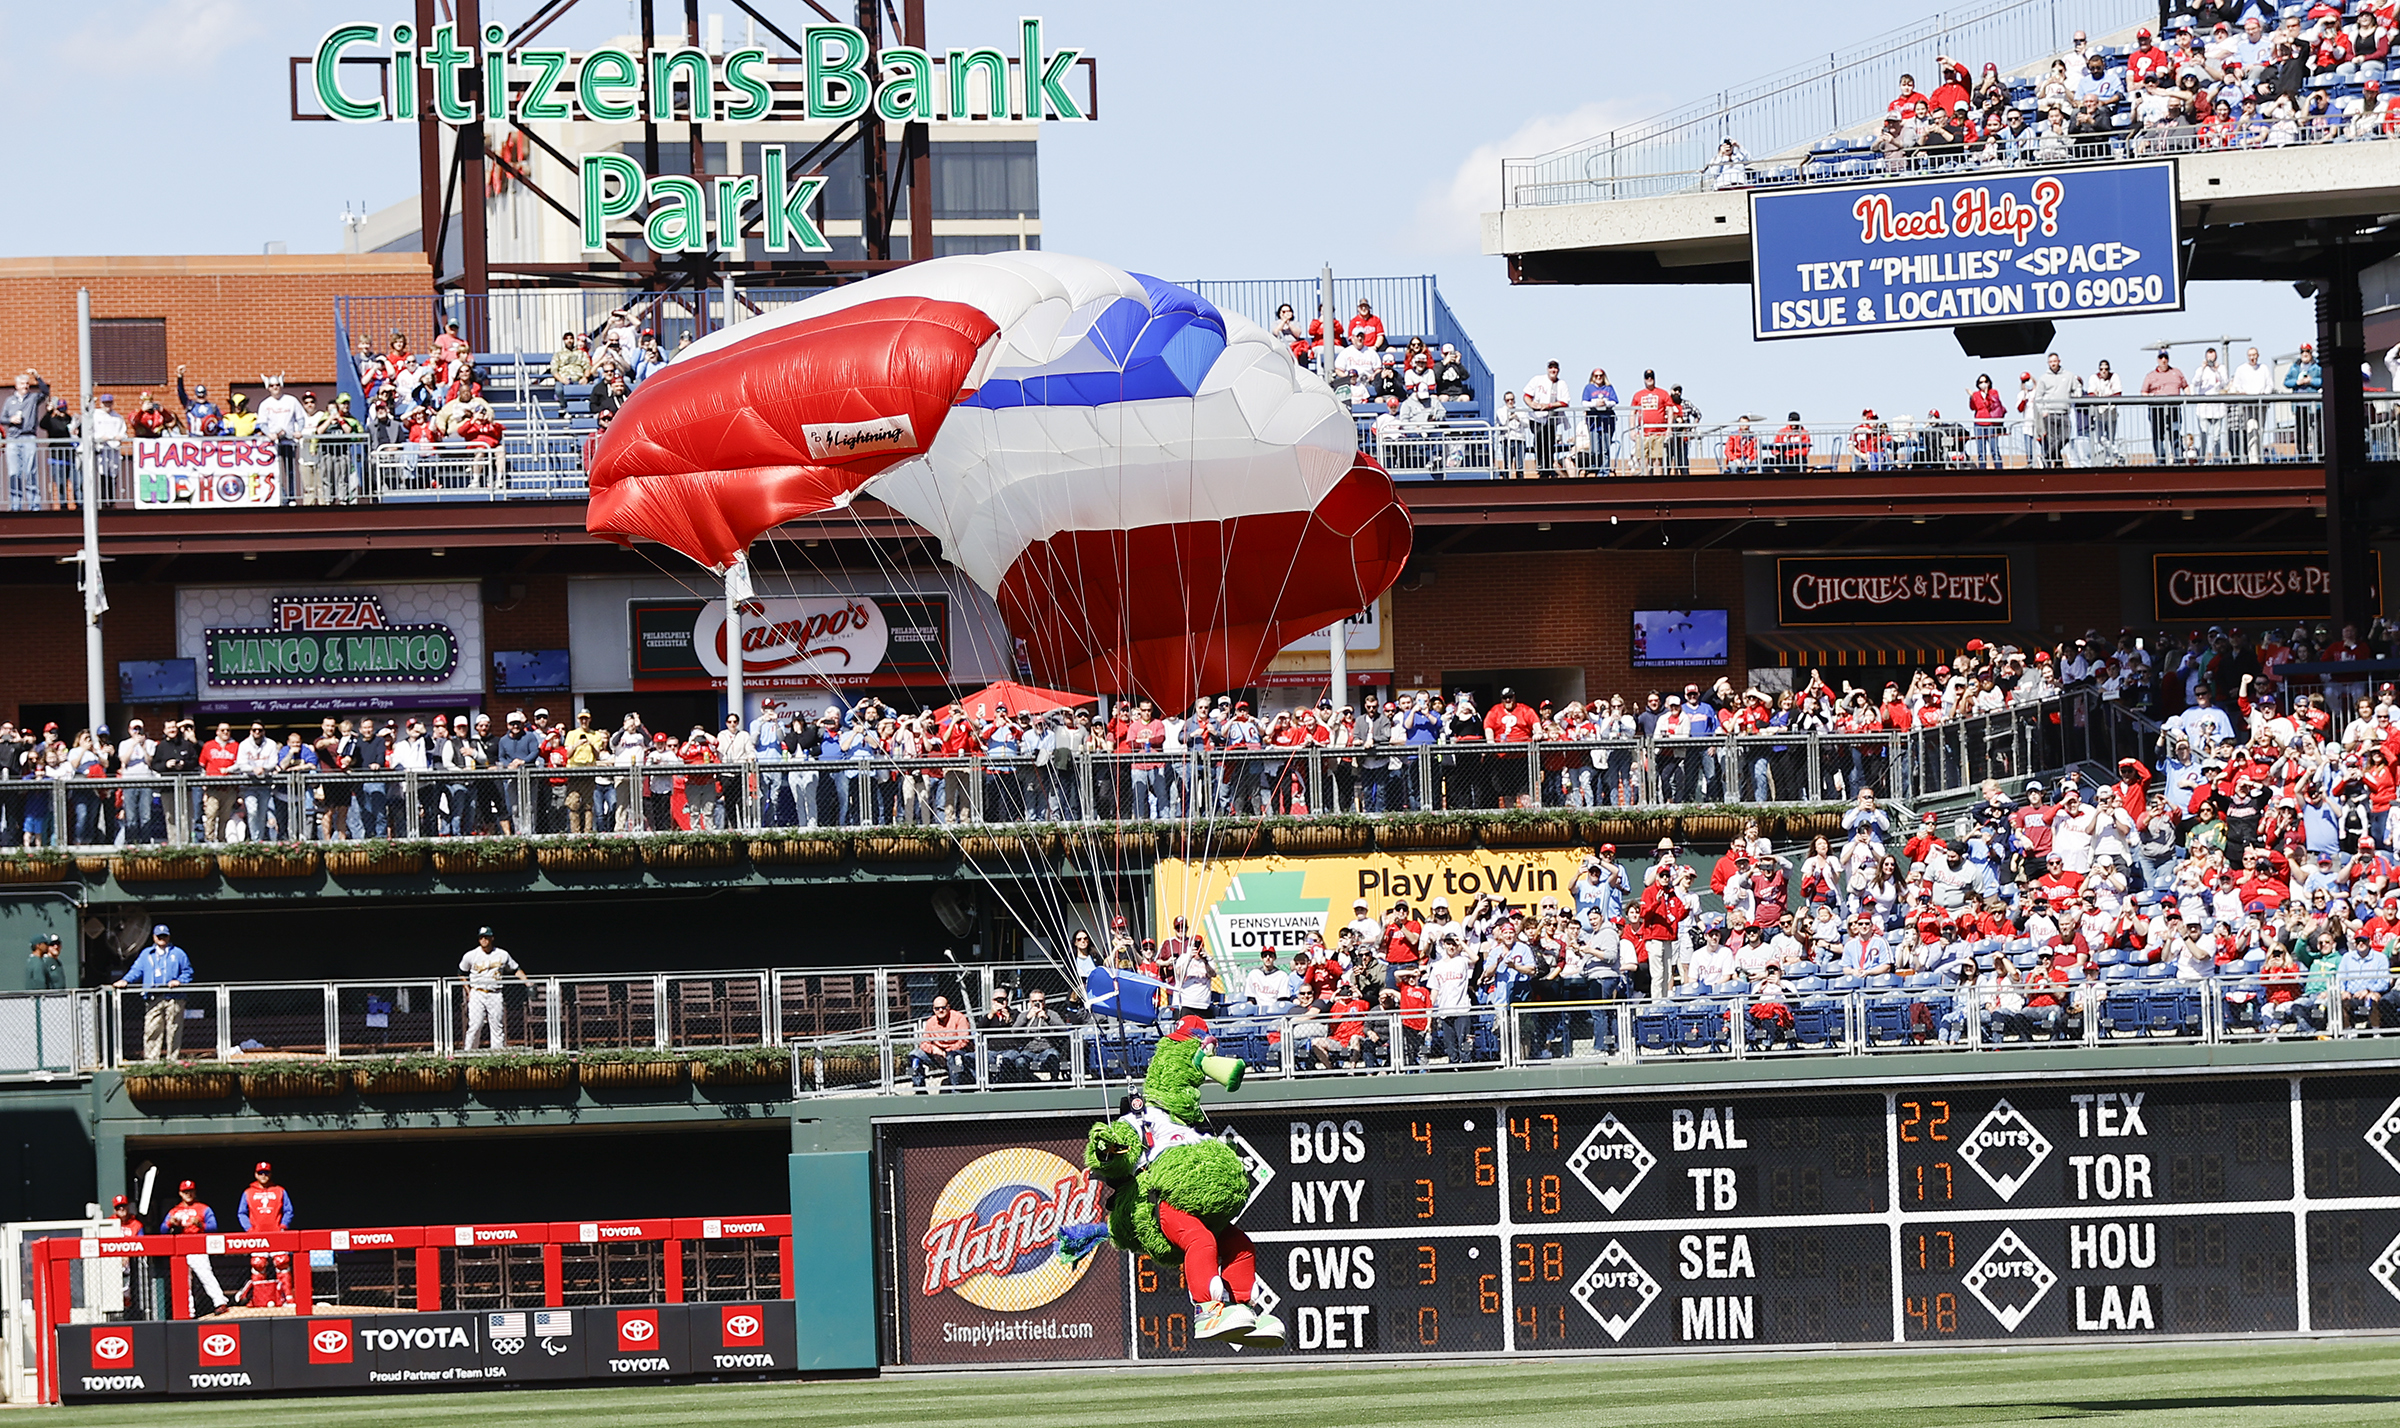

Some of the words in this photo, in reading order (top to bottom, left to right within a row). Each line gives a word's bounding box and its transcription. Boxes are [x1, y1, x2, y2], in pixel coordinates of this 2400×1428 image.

[313, 20, 774, 124] Citizens
[802, 15, 1087, 124] Bank
[578, 144, 834, 254] Park
[1852, 193, 1950, 245] Need
[1952, 176, 2065, 248] Help?
[1797, 262, 1864, 293] TEXT
[2015, 241, 2142, 276] <SPACE>
[1771, 297, 1847, 330] ISSUE
[1857, 297, 1877, 322] &
[1885, 284, 2025, 321] LOCATION
[2031, 280, 2070, 310] TO
[2075, 273, 2164, 308] 69050
[139, 440, 276, 468] HARPER'S
[834, 428, 904, 449] Lightning
[140, 473, 276, 503] HEROES
[1792, 573, 1911, 610] CHICKIE'S
[1913, 577, 1927, 597] &
[1931, 571, 2003, 605] PETE'S
[2168, 569, 2286, 606] CHICKIE'S
[2287, 570, 2302, 593] &
[280, 602, 384, 631] PIZZA
[217, 636, 320, 675] MANCO
[322, 637, 343, 673] &
[346, 633, 448, 671] MANCO
[714, 601, 870, 672] Campo's
[773, 678, 808, 686] STREET
[848, 676, 870, 684] CITY
[250, 701, 266, 710] The
[269, 700, 290, 711] First
[309, 700, 329, 710] Last
[331, 699, 356, 708] Name
[359, 699, 367, 707] in
[370, 697, 393, 709] Pizza
[1358, 867, 1434, 901] Play
[1443, 868, 1481, 894] to
[1484, 862, 1558, 893] Win
[1230, 917, 1320, 929] PENNSYLVANIA
[1231, 930, 1319, 947] LOTTER
[1509, 1113, 1560, 1153] 47
[1671, 1106, 1748, 1152] BAL
[1900, 1100, 1950, 1143] 22
[2070, 1091, 2147, 1138] TEX
[1289, 1119, 1366, 1165] BOS
[1410, 1121, 1434, 1156] 4
[1586, 1142, 1636, 1162] OUTS
[1979, 1129, 2030, 1149] OUTS
[1473, 1146, 1496, 1187] 6
[1917, 1162, 1954, 1200] 17
[2068, 1153, 2154, 1200] TOR
[1291, 1179, 1366, 1224] NYY
[1415, 1178, 1435, 1218] 3
[1526, 1174, 1562, 1214] 18
[1687, 1166, 1738, 1212] TB
[101, 1241, 144, 1253] TOYOTA
[227, 1237, 270, 1249] TOYOTA
[351, 1233, 394, 1245] TOYOTA
[475, 1229, 518, 1241] TOYOTA
[600, 1226, 642, 1238] TOYOTA
[723, 1222, 765, 1234] TOYOTA
[921, 1173, 1101, 1296] Hatfield
[2069, 1223, 2157, 1270] HOU
[1288, 1245, 1376, 1291] CWS
[1417, 1245, 1437, 1285] 3
[1516, 1242, 1565, 1284] 38
[1678, 1234, 1756, 1281] SEA
[1919, 1231, 1955, 1270] 17
[1590, 1272, 1640, 1291] OUTS
[1984, 1261, 2035, 1280] OUTS
[1478, 1273, 1500, 1315] 6
[1906, 1293, 1958, 1333] 48
[2075, 1284, 2155, 1332] LAA
[942, 1320, 1093, 1348] SimplyHatfield.com
[1139, 1312, 1187, 1352] 40
[1298, 1304, 1370, 1350] DET
[1516, 1305, 1566, 1341] 41
[1680, 1295, 1755, 1342] MIN
[360, 1326, 470, 1351] TOYOTA
[189, 1372, 252, 1388] TOYOTA
[370, 1370, 402, 1382] Proud
[403, 1369, 442, 1381] Partner
[442, 1368, 453, 1379] of
[453, 1367, 482, 1379] Team
[484, 1366, 506, 1378] USA
[609, 1356, 670, 1373] TOYOTA
[713, 1353, 774, 1370] TOYOTA
[81, 1374, 145, 1392] TOYOTA
